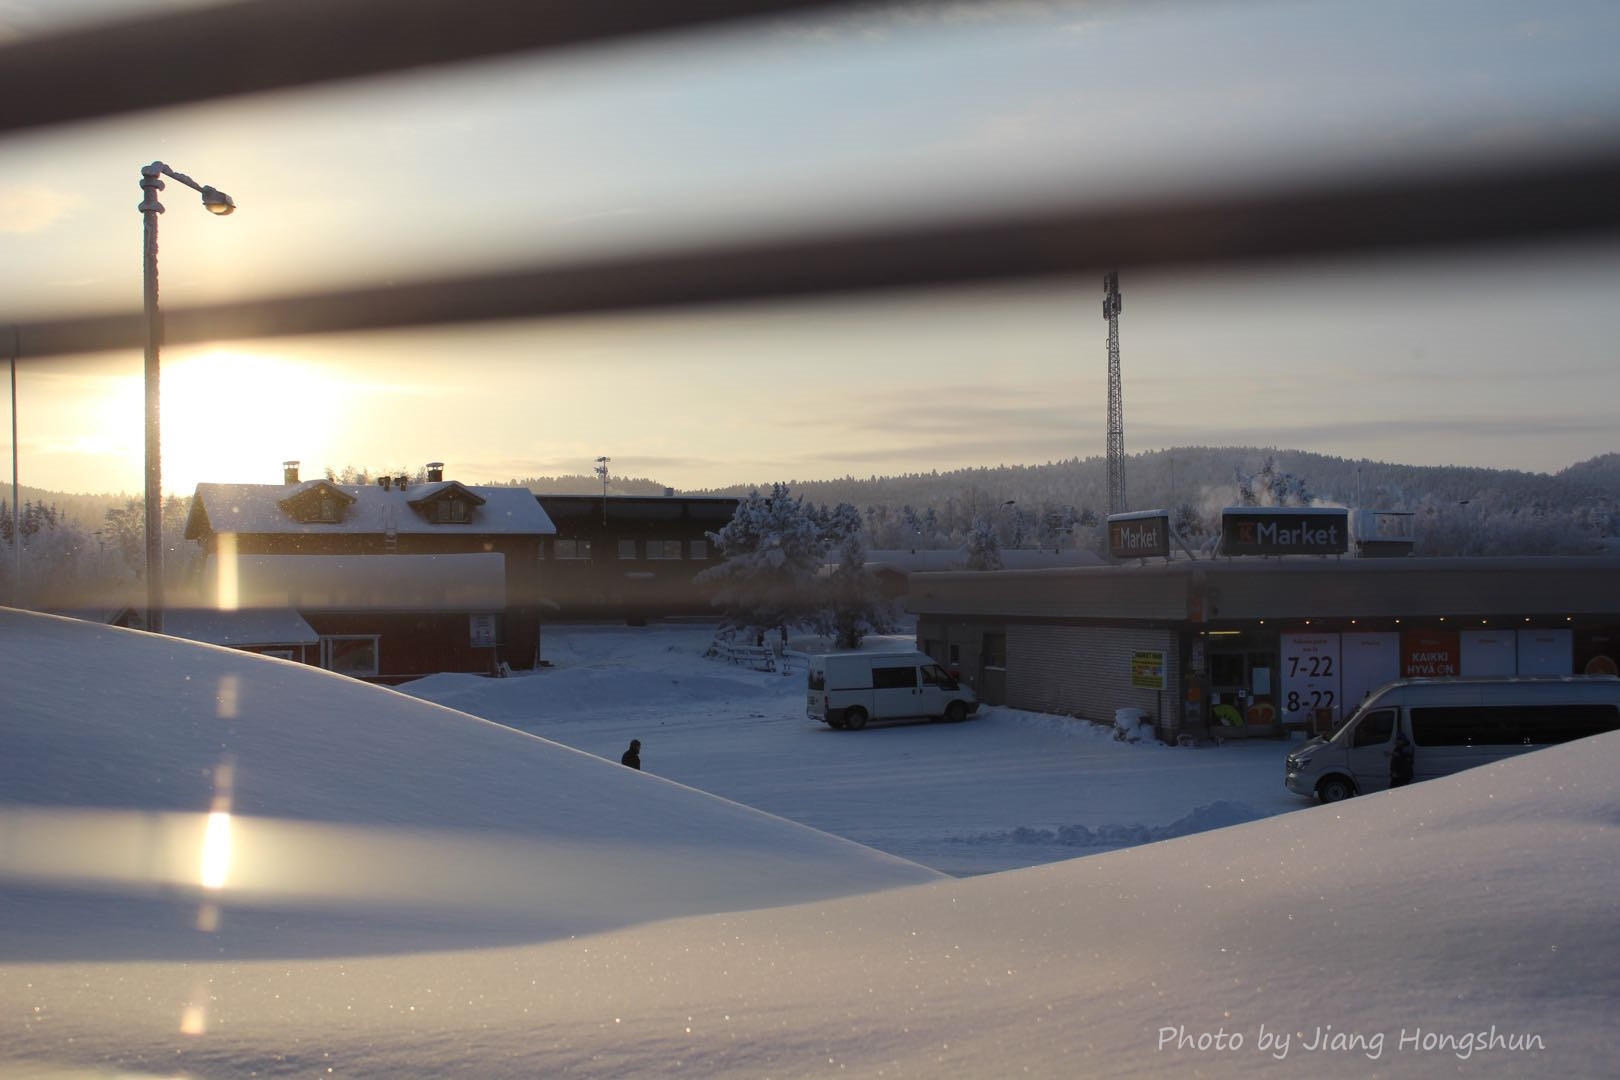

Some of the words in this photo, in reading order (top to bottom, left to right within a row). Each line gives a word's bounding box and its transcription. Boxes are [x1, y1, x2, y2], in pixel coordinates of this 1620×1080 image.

[1120, 524, 1157, 549] Market
[1256, 520, 1337, 545] Market
[1288, 656, 1333, 677] 7-22
[1412, 651, 1449, 662] KAIKKI
[1407, 662, 1435, 674] HYVÄ
[1287, 691, 1334, 712] 8-22
